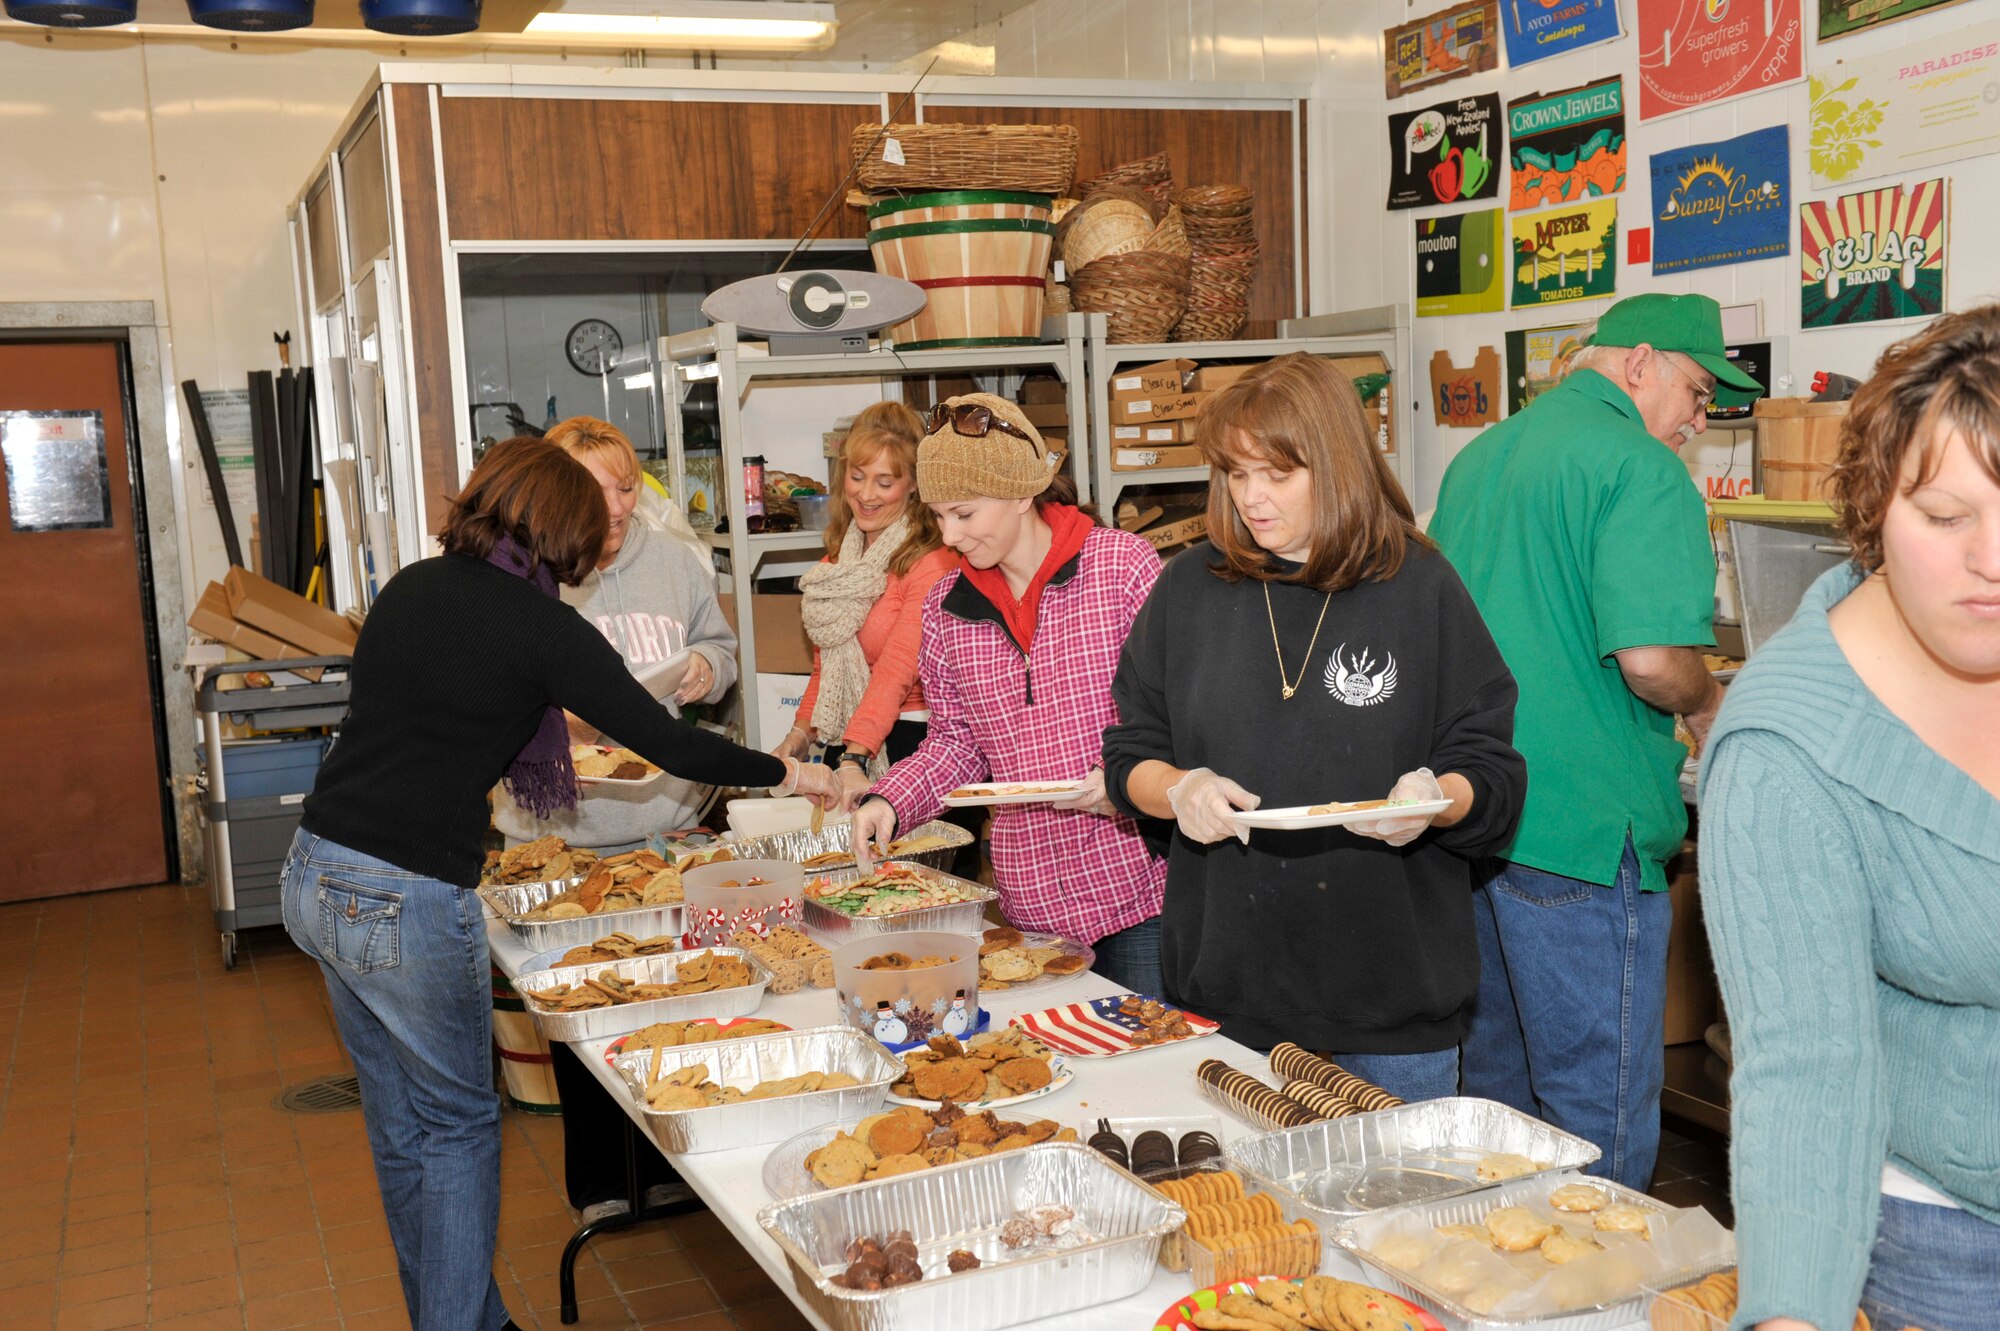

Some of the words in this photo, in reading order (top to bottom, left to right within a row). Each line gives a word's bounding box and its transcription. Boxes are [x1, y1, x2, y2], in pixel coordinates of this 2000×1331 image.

[1527, 14, 1552, 31] AYCO
[1552, 4, 1586, 23] FARMS
[1401, 34, 1417, 60] Red
[1686, 19, 1749, 51] superfresh
[1702, 39, 1749, 67] growers
[1761, 19, 1799, 82] apples
[1899, 43, 1999, 80] PARADISE
[1399, 57, 1422, 81] Robin
[1645, 64, 1748, 102] www.superfreshgrowers.com
[1446, 114, 1462, 126] New
[1463, 107, 1490, 122] Zealand
[1458, 98, 1477, 111] Fresh
[1512, 105, 1562, 132] CROWN
[1659, 188, 1726, 224] Sunny
[1728, 174, 1780, 207] Cove
[1728, 201, 1782, 216] CITRUS
[1418, 235, 1457, 254] mouton
[1535, 213, 1590, 252] MEYER
[1655, 258, 1689, 270] PREMIUM
[1693, 250, 1742, 265] CALIFORNIA
[1746, 243, 1786, 255] ORANGES
[1816, 231, 1876, 280] J&J
[1879, 230, 1927, 266] AG
[1846, 266, 1891, 286] BRAND
[1539, 286, 1584, 301] TOMATOES
[1141, 379, 1164, 393] Clear
[1152, 404, 1174, 417] Clear
